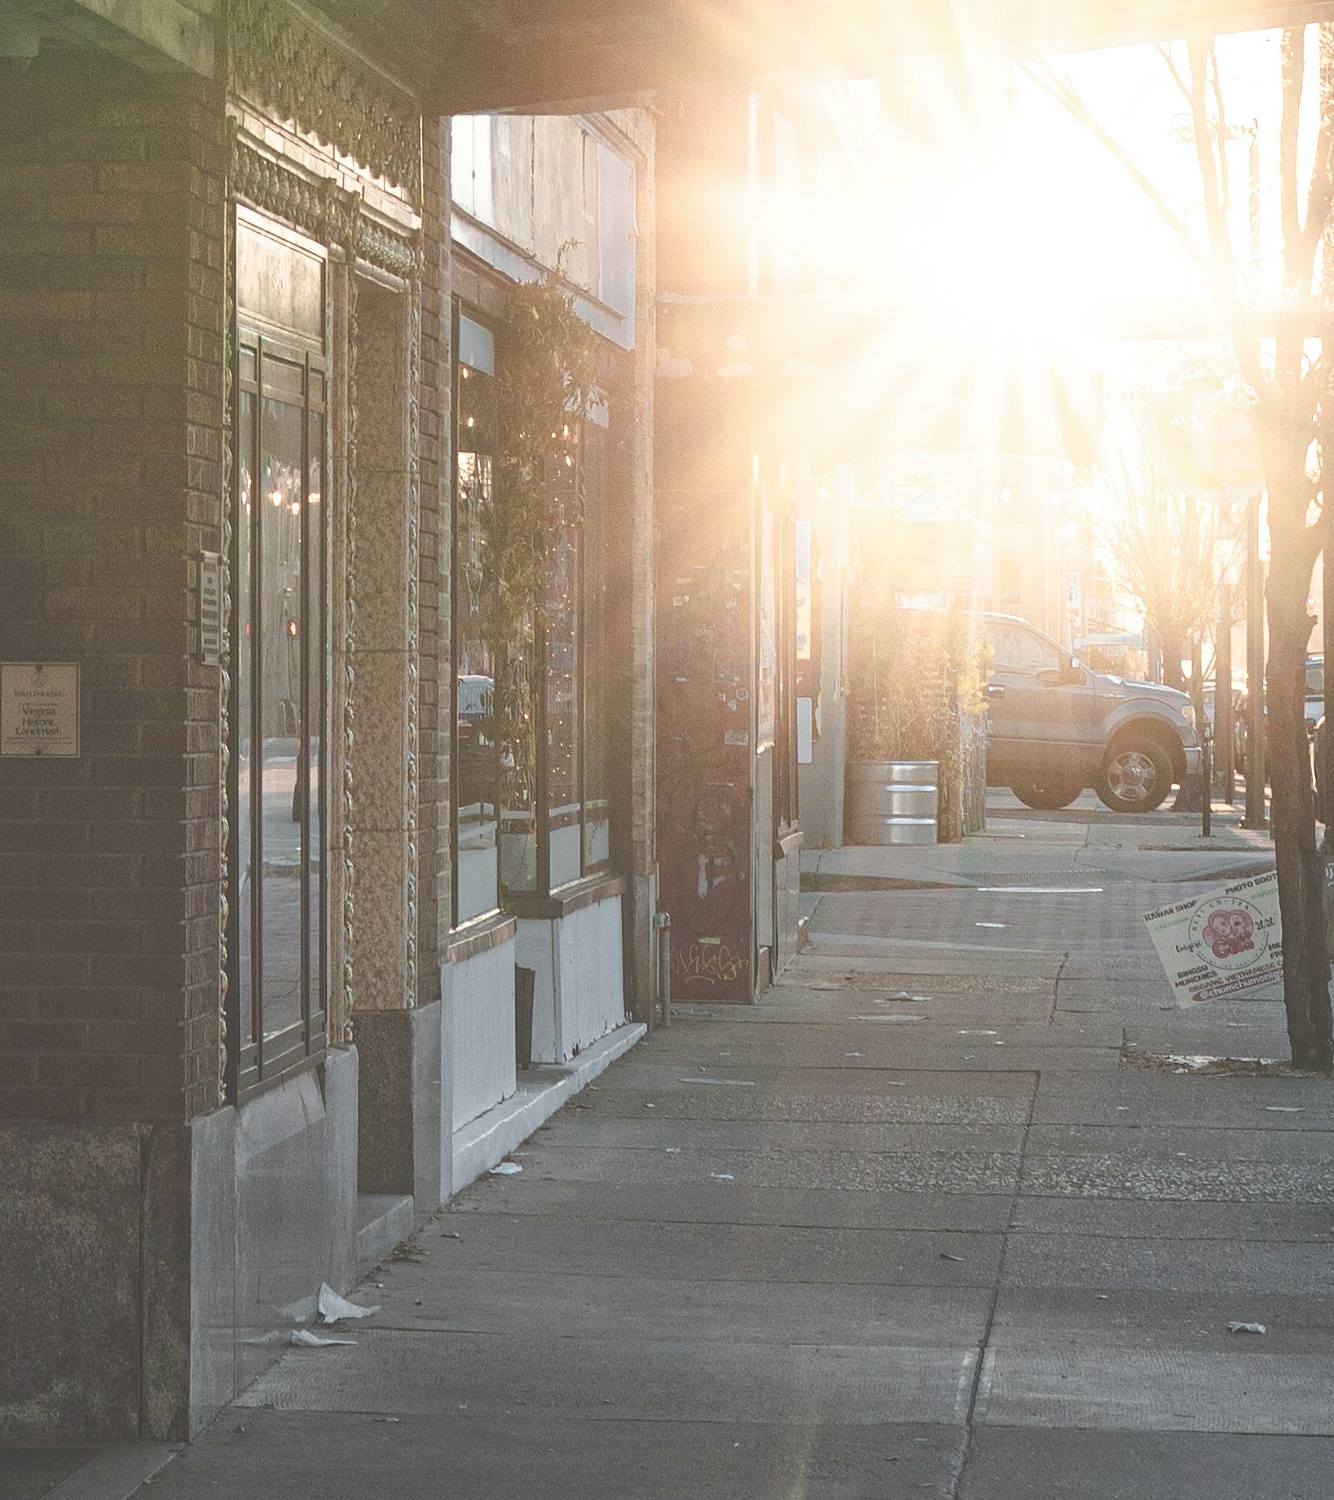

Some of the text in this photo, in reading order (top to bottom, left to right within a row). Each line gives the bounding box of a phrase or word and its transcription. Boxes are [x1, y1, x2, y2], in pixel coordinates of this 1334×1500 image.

[1225, 881, 1254, 895] PHOTO
[1176, 900, 1197, 913] SHOP
[1189, 978, 1224, 993] ORGANIC
[1225, 962, 1275, 983] VIETNAMESE
